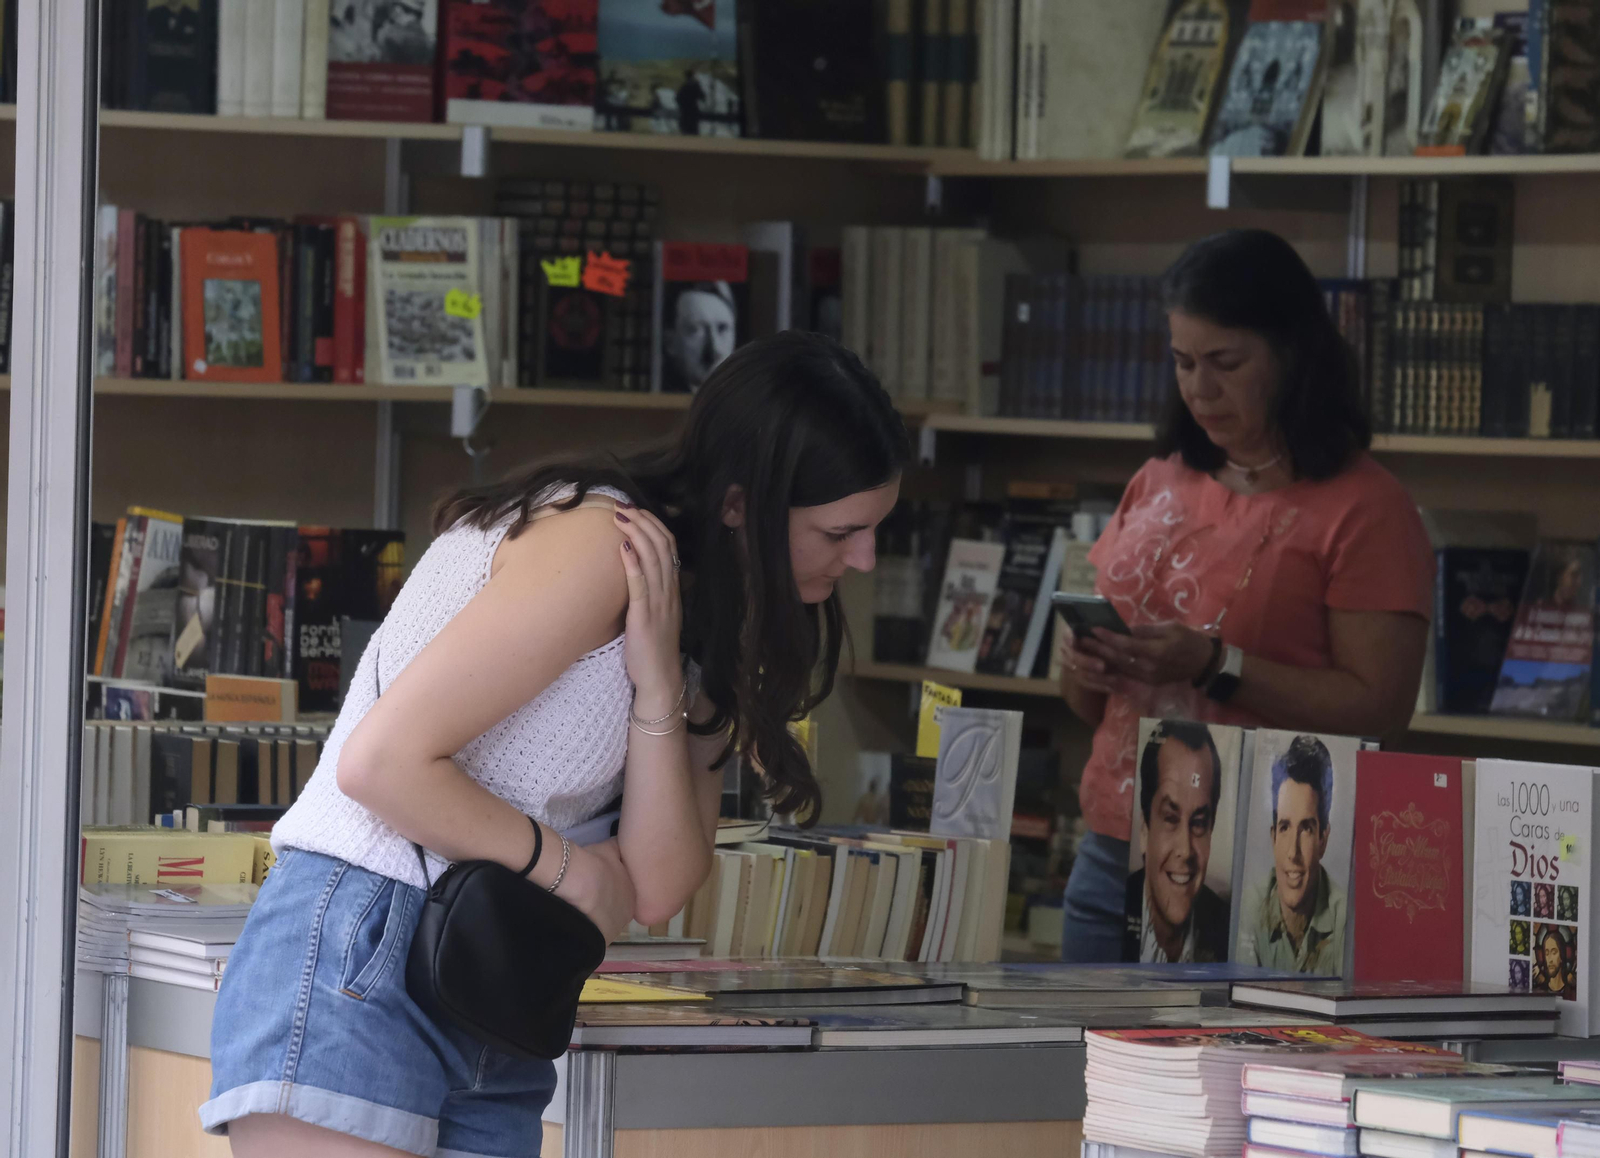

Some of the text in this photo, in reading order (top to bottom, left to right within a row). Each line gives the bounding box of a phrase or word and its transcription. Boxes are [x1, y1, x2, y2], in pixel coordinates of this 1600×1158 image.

[1497, 781, 1579, 816] Las 1.000 y una
[1510, 815, 1565, 841] Caras de
[1509, 840, 1560, 881] Dios
